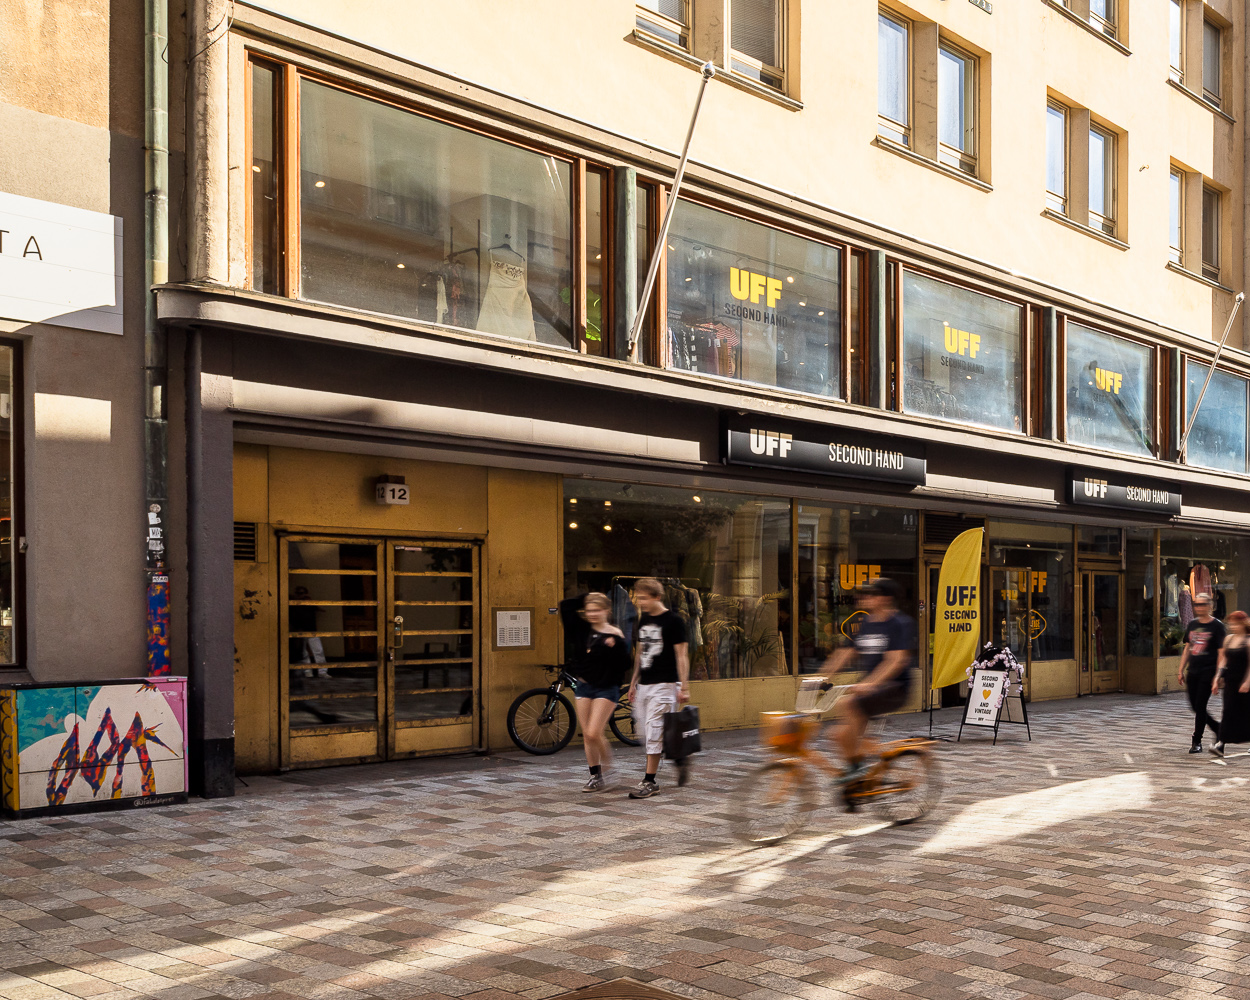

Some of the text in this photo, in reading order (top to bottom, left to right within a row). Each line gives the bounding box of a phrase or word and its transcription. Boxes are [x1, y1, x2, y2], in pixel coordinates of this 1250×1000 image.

[730, 267, 782, 308] UFF
[725, 303, 788, 328] SECOND HAND
[944, 326, 981, 359] UFF
[941, 355, 966, 370] SECOND
[1095, 367, 1122, 394] UFF
[750, 429, 904, 470] UFF SECOND HAND
[377, 487, 385, 498] 12
[389, 488, 407, 500] 12
[1084, 477, 1169, 504] UFF SECOND HAND
[840, 564, 881, 591] UFF
[1018, 571, 1047, 593] UFF
[946, 586, 976, 606] UFF
[944, 610, 977, 620] SECOND
[949, 623, 972, 632] HAND
